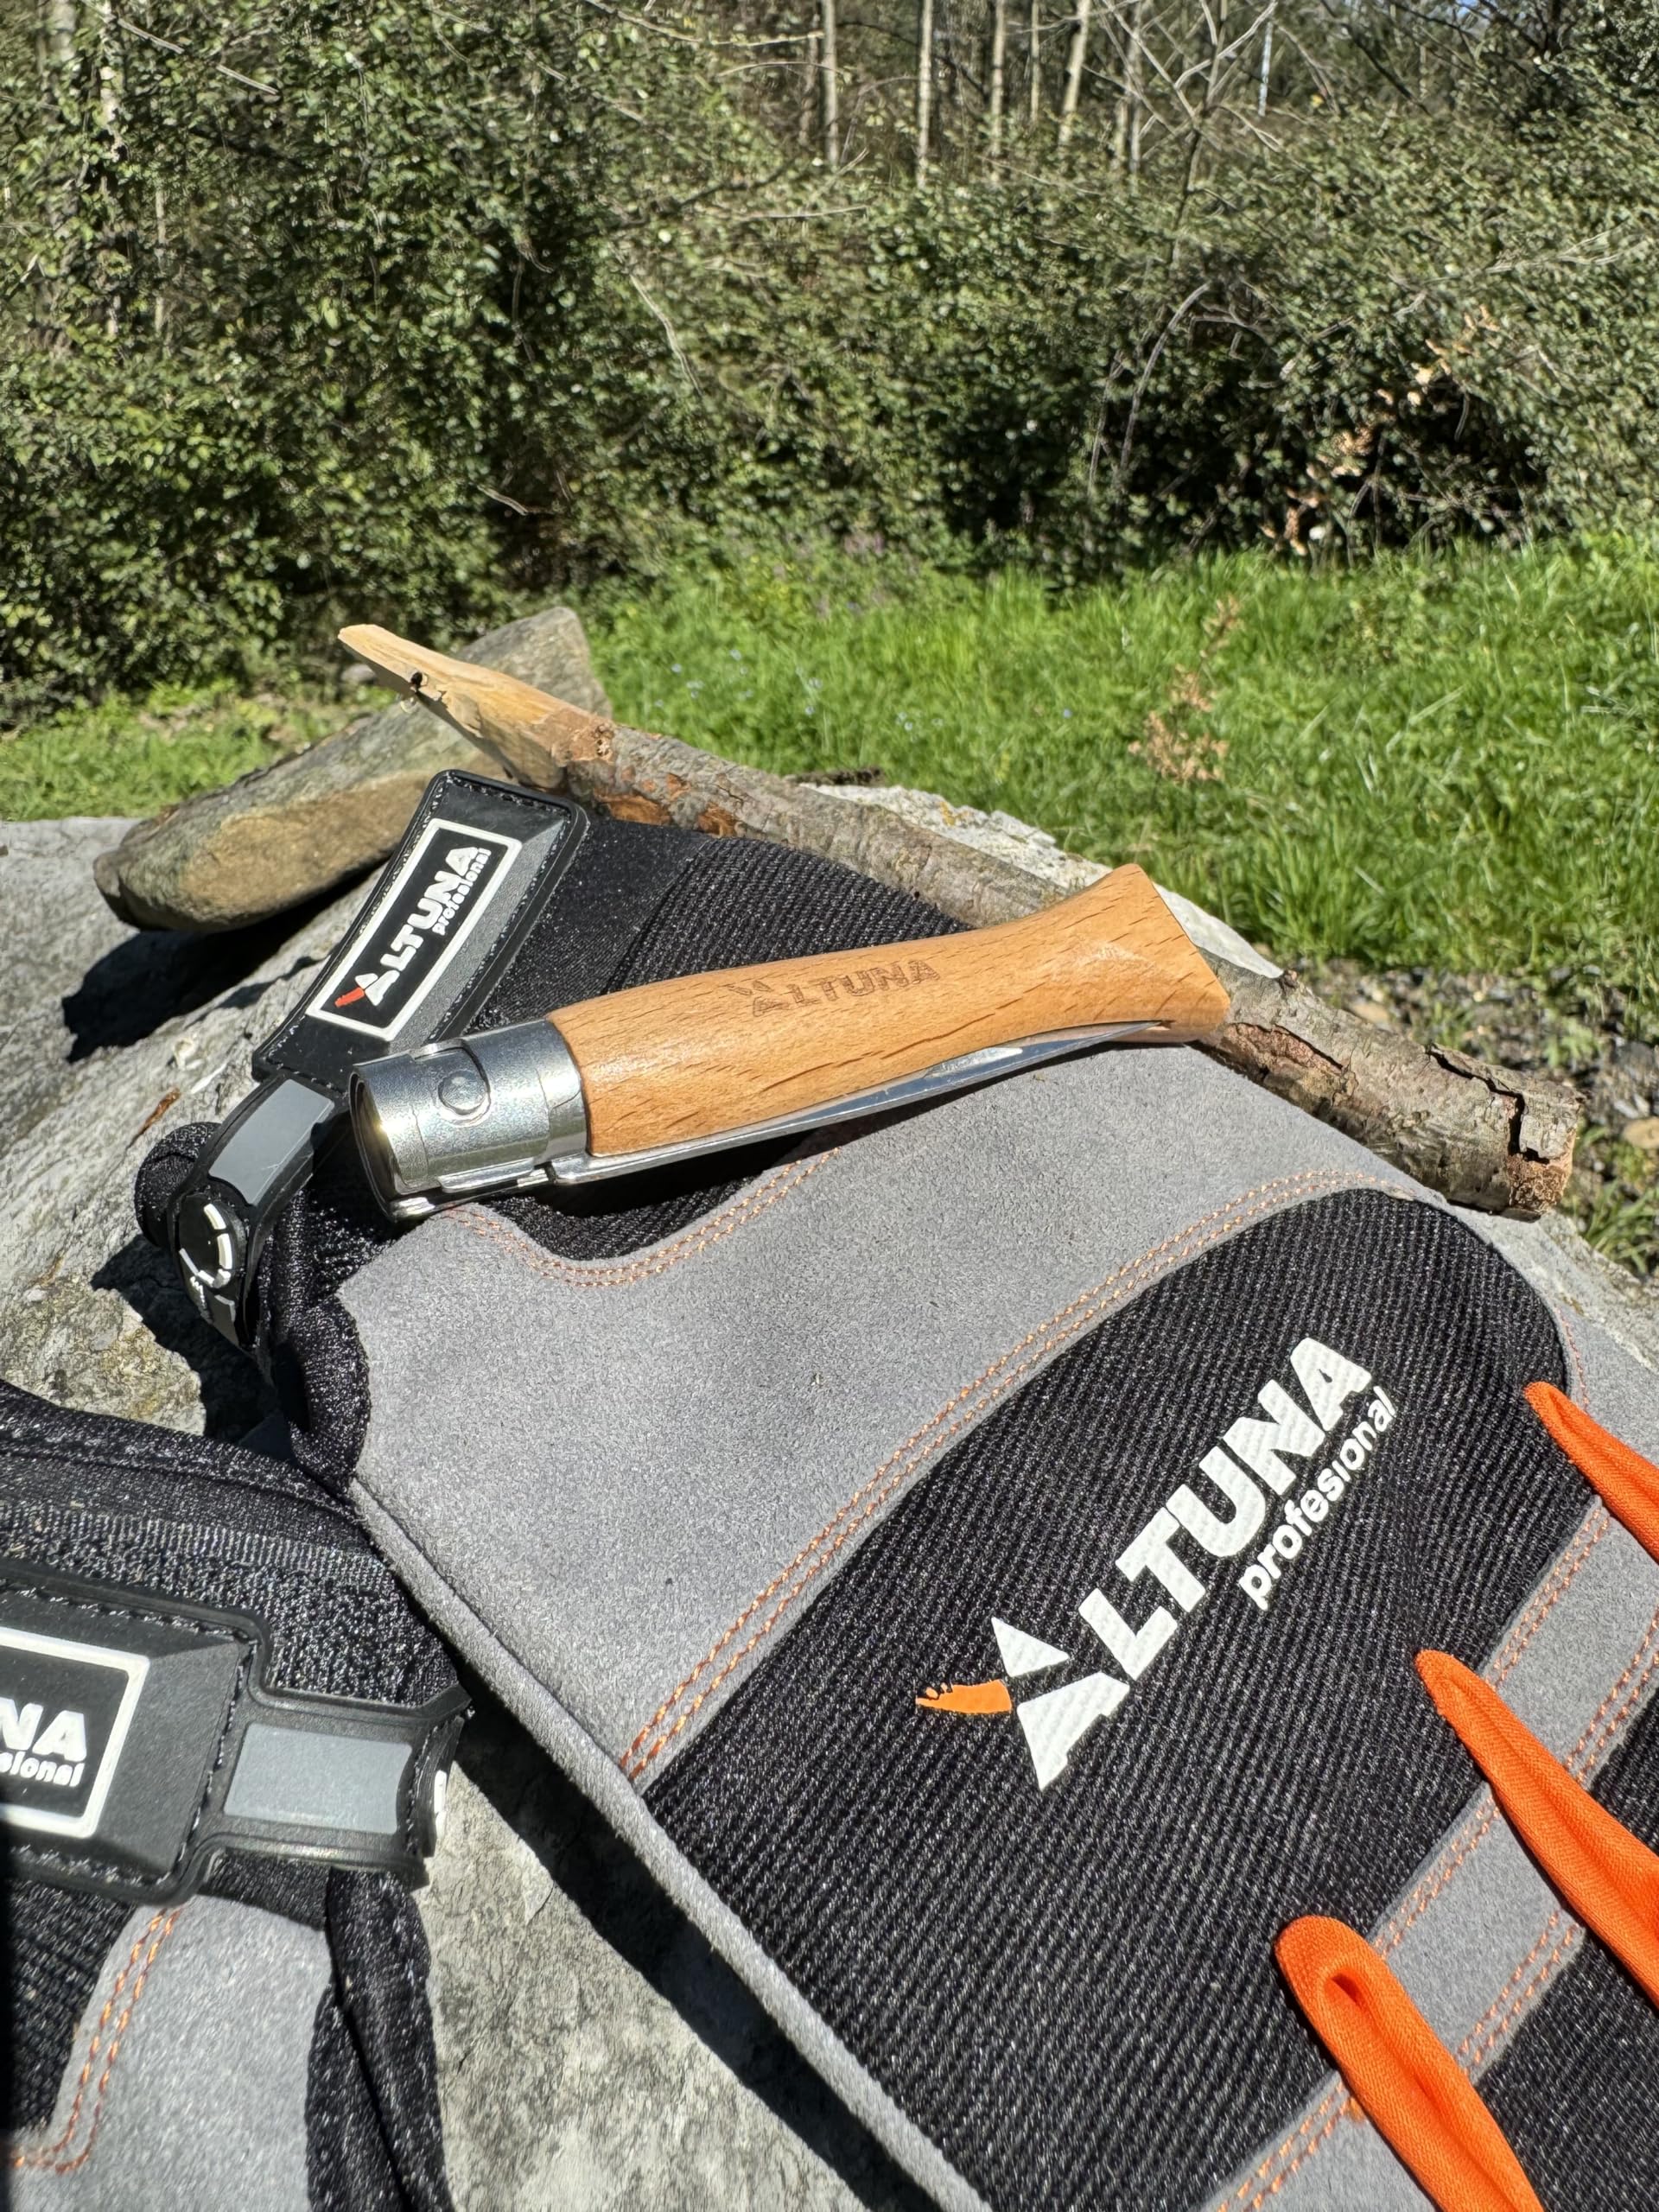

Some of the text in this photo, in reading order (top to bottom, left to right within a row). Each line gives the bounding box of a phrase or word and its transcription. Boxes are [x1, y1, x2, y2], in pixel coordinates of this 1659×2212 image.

[354, 847, 479, 1007] ALTUNA
[990, 1337, 1373, 1791] ALTUNA
[1237, 1384, 1397, 1611] profesional
